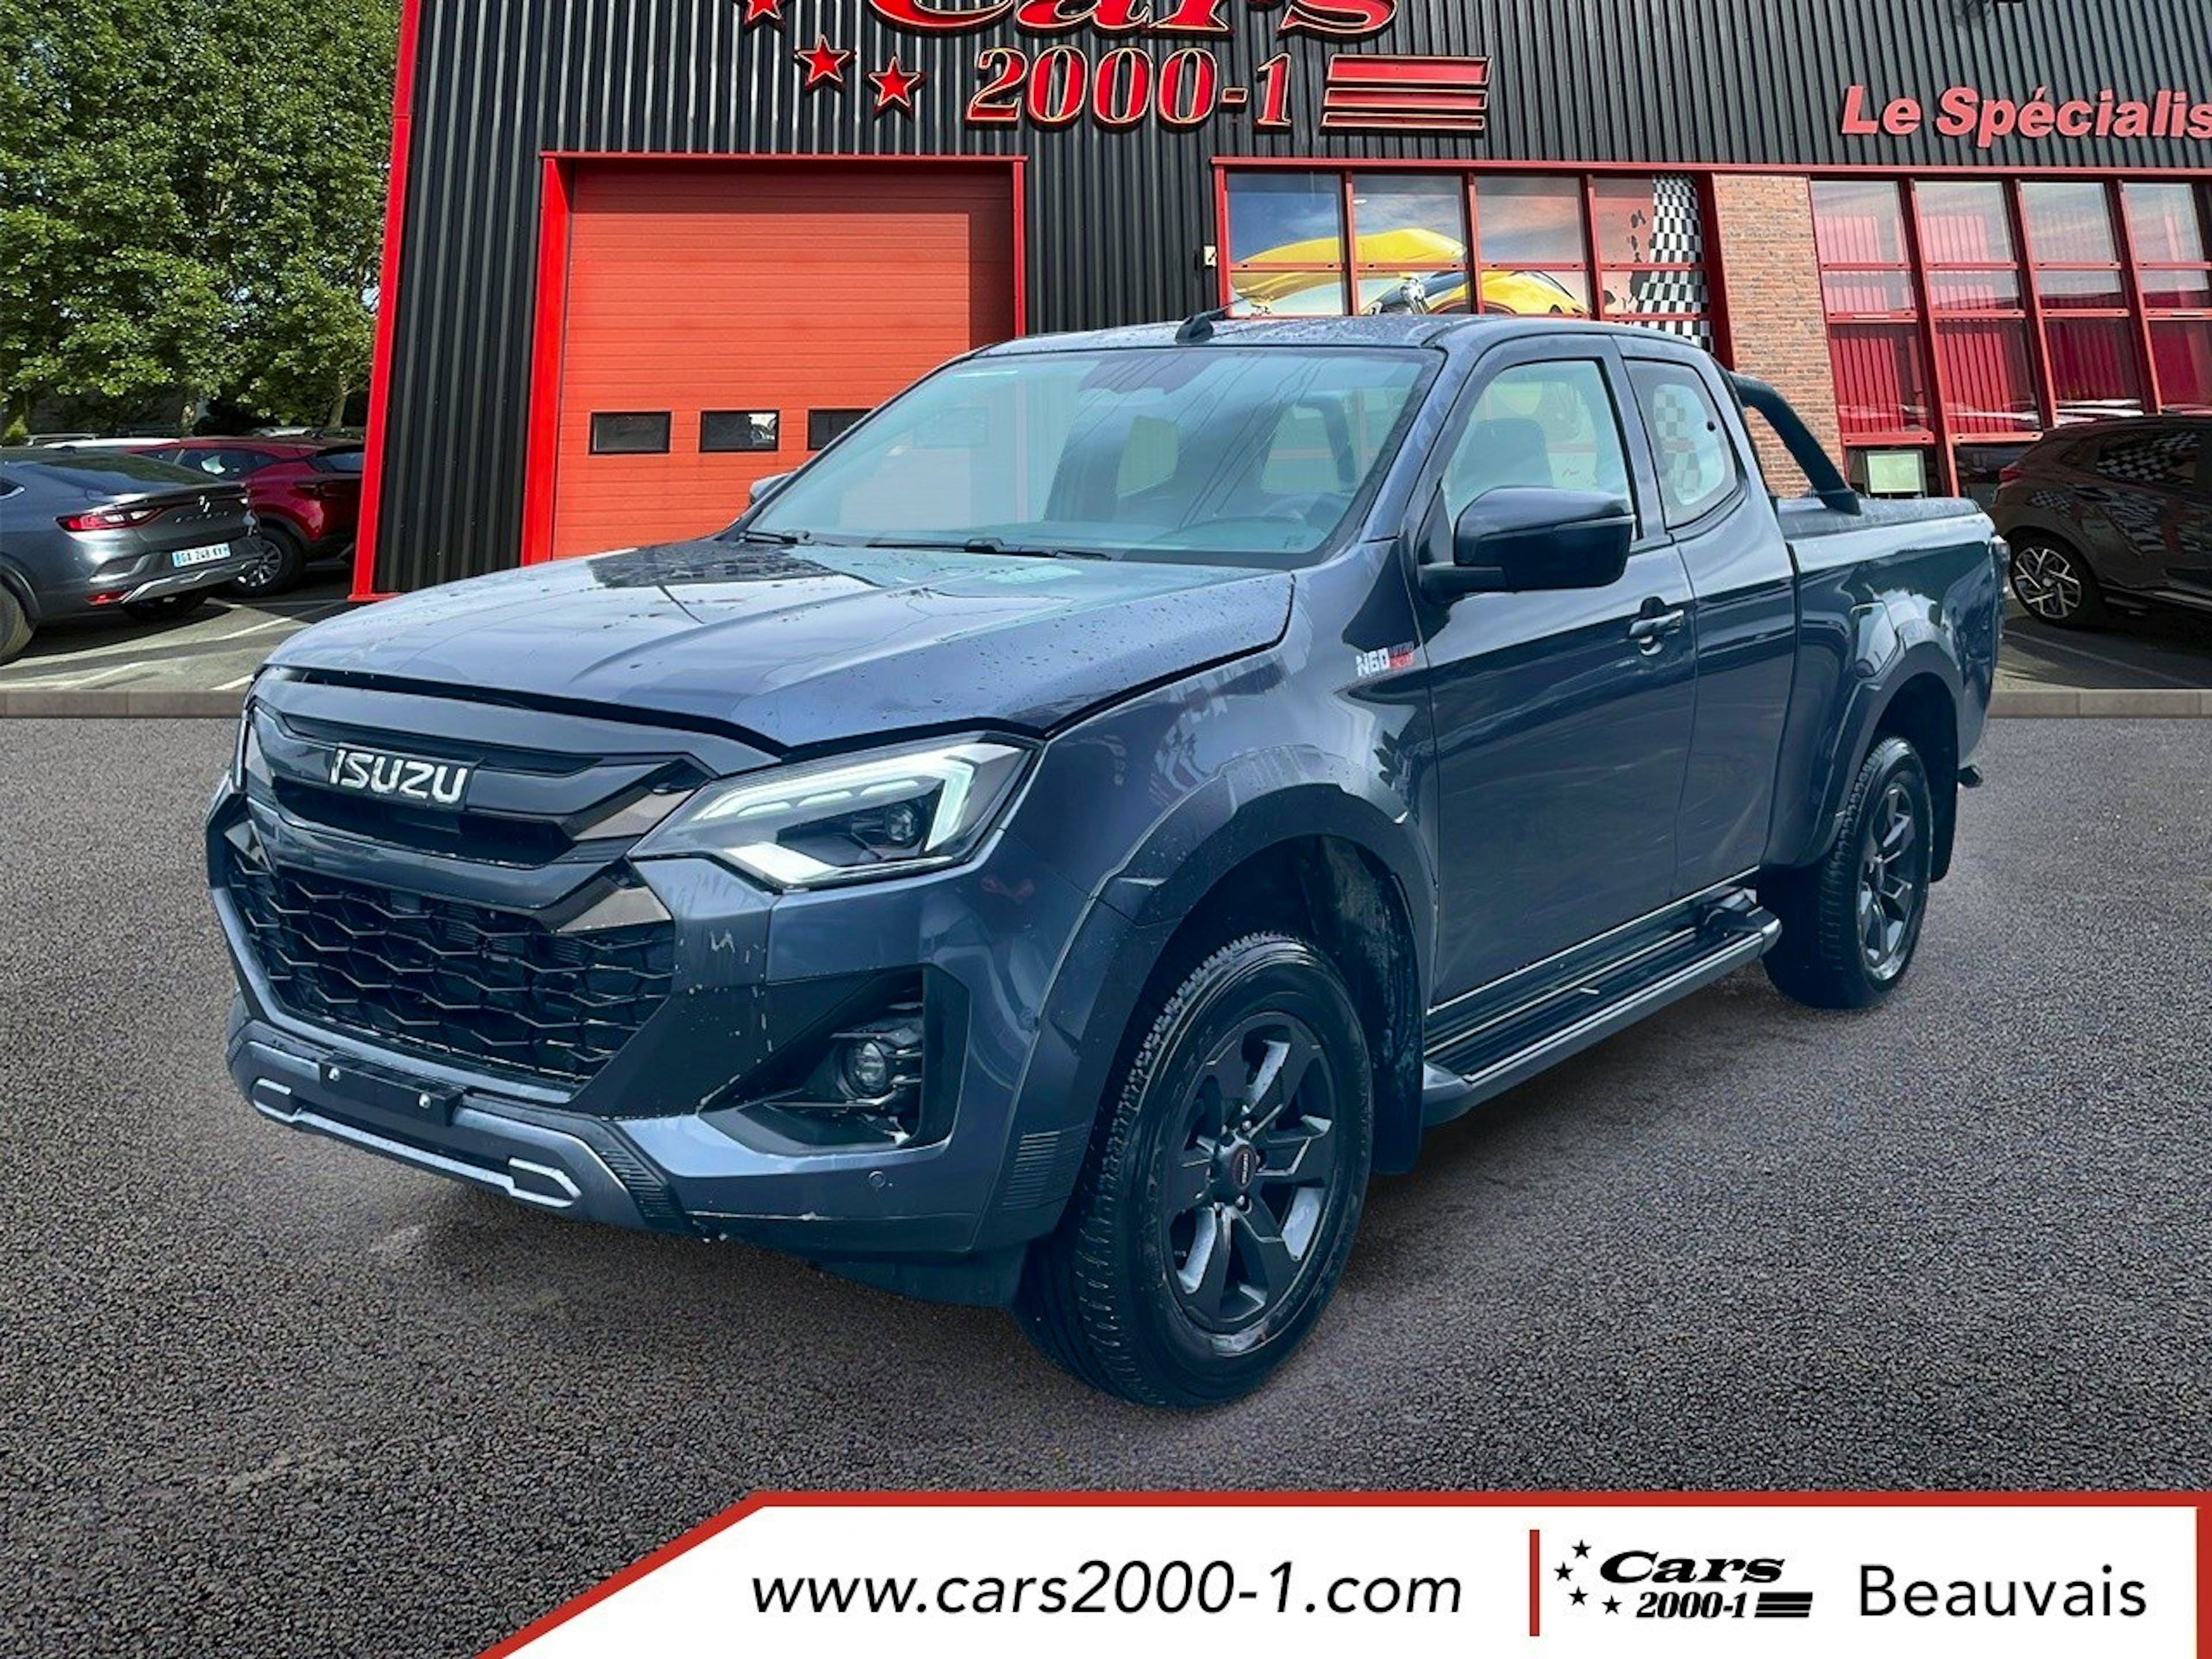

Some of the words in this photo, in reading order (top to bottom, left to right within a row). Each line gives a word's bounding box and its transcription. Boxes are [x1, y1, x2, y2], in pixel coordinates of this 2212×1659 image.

[964, 45, 1293, 127] 2000-1
[1841, 85, 1922, 135] Le
[329, 749, 468, 804] ISUZU
